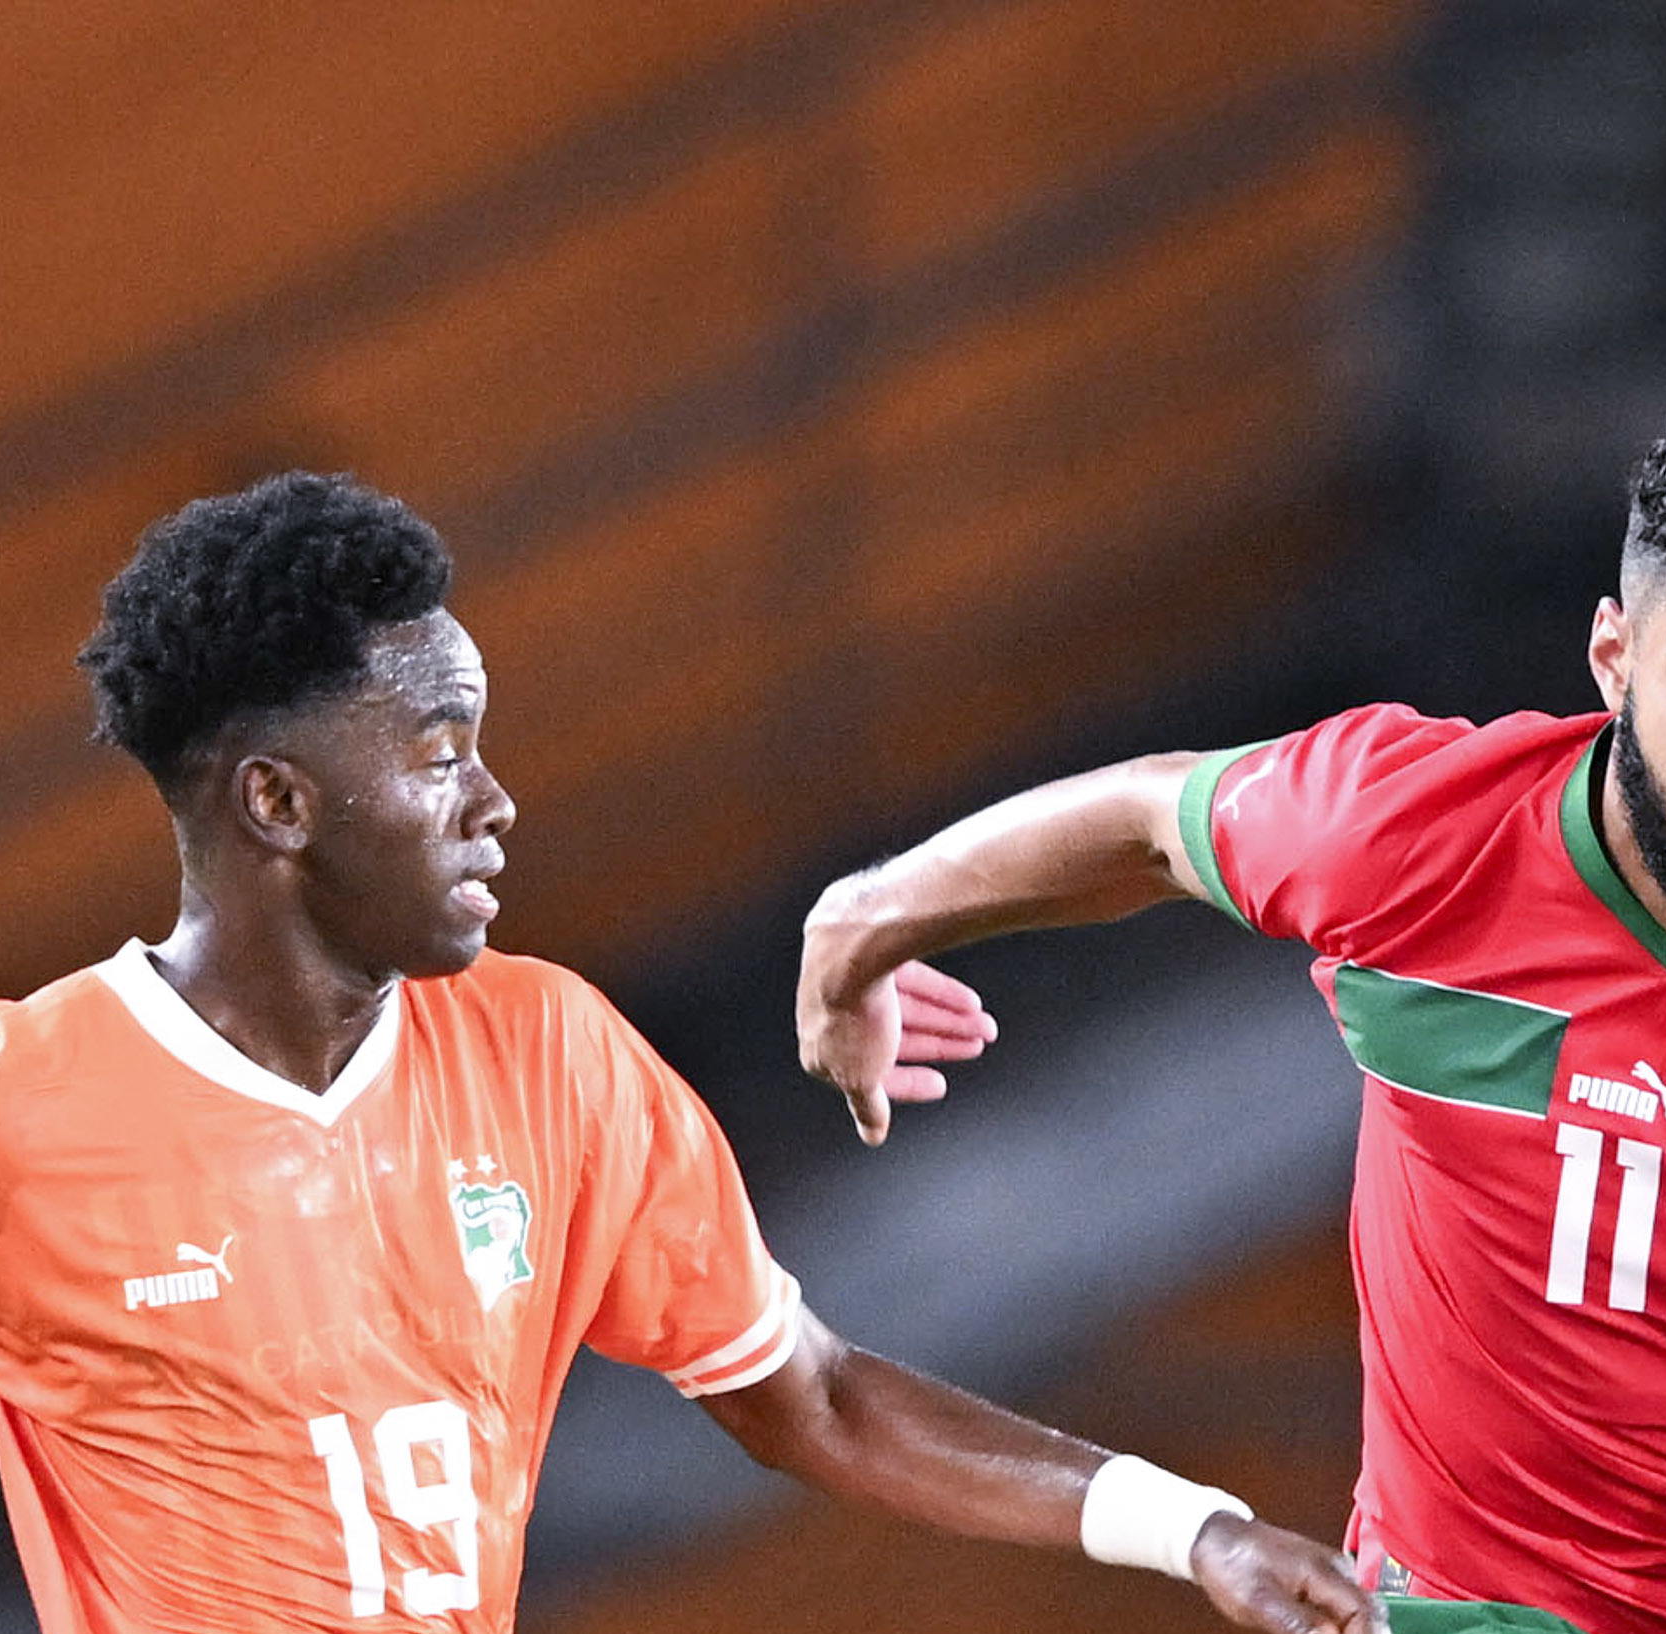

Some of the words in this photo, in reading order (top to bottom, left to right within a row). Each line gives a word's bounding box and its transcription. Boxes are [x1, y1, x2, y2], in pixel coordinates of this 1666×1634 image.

[1567, 1072, 1660, 1123] PUMA
[1545, 1121, 1663, 1313] 11
[123, 1267, 221, 1311] PUMA
[308, 1399, 479, 1617] 19
